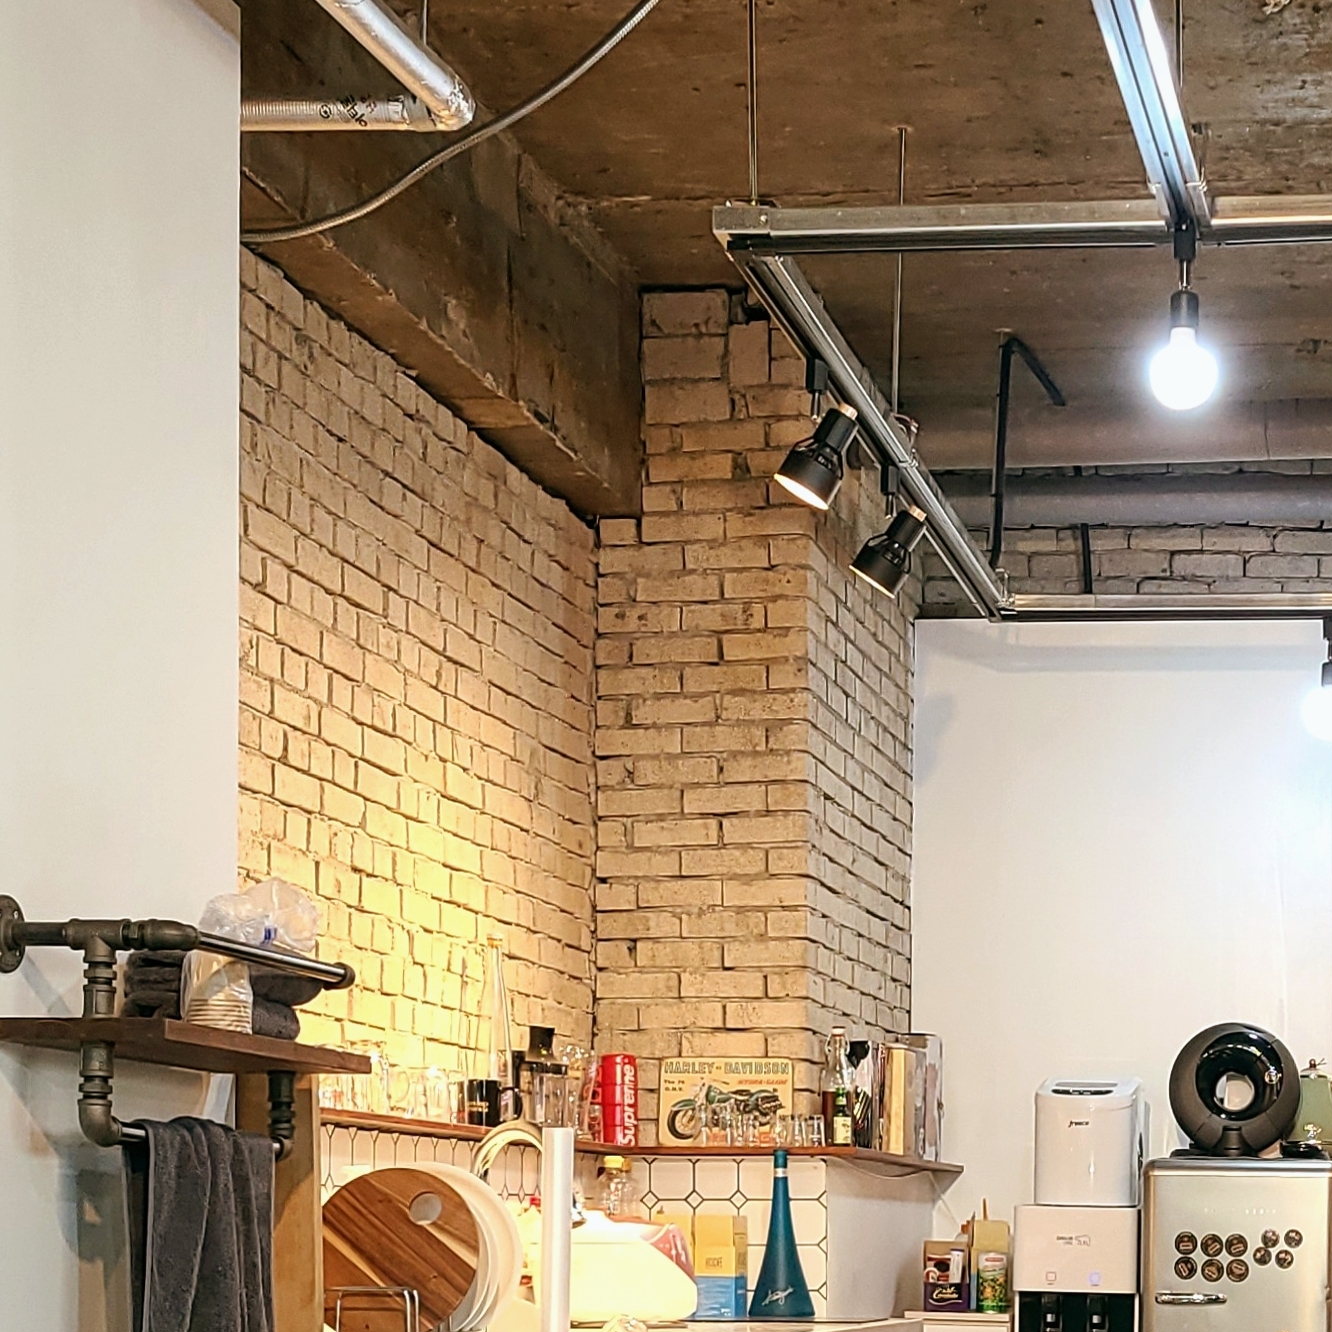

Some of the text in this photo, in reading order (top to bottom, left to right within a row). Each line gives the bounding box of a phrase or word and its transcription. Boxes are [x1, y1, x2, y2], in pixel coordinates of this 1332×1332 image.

[664, 1061, 790, 1075] HARLEY DAVIDSON
[622, 1064, 638, 1147] Supreme
